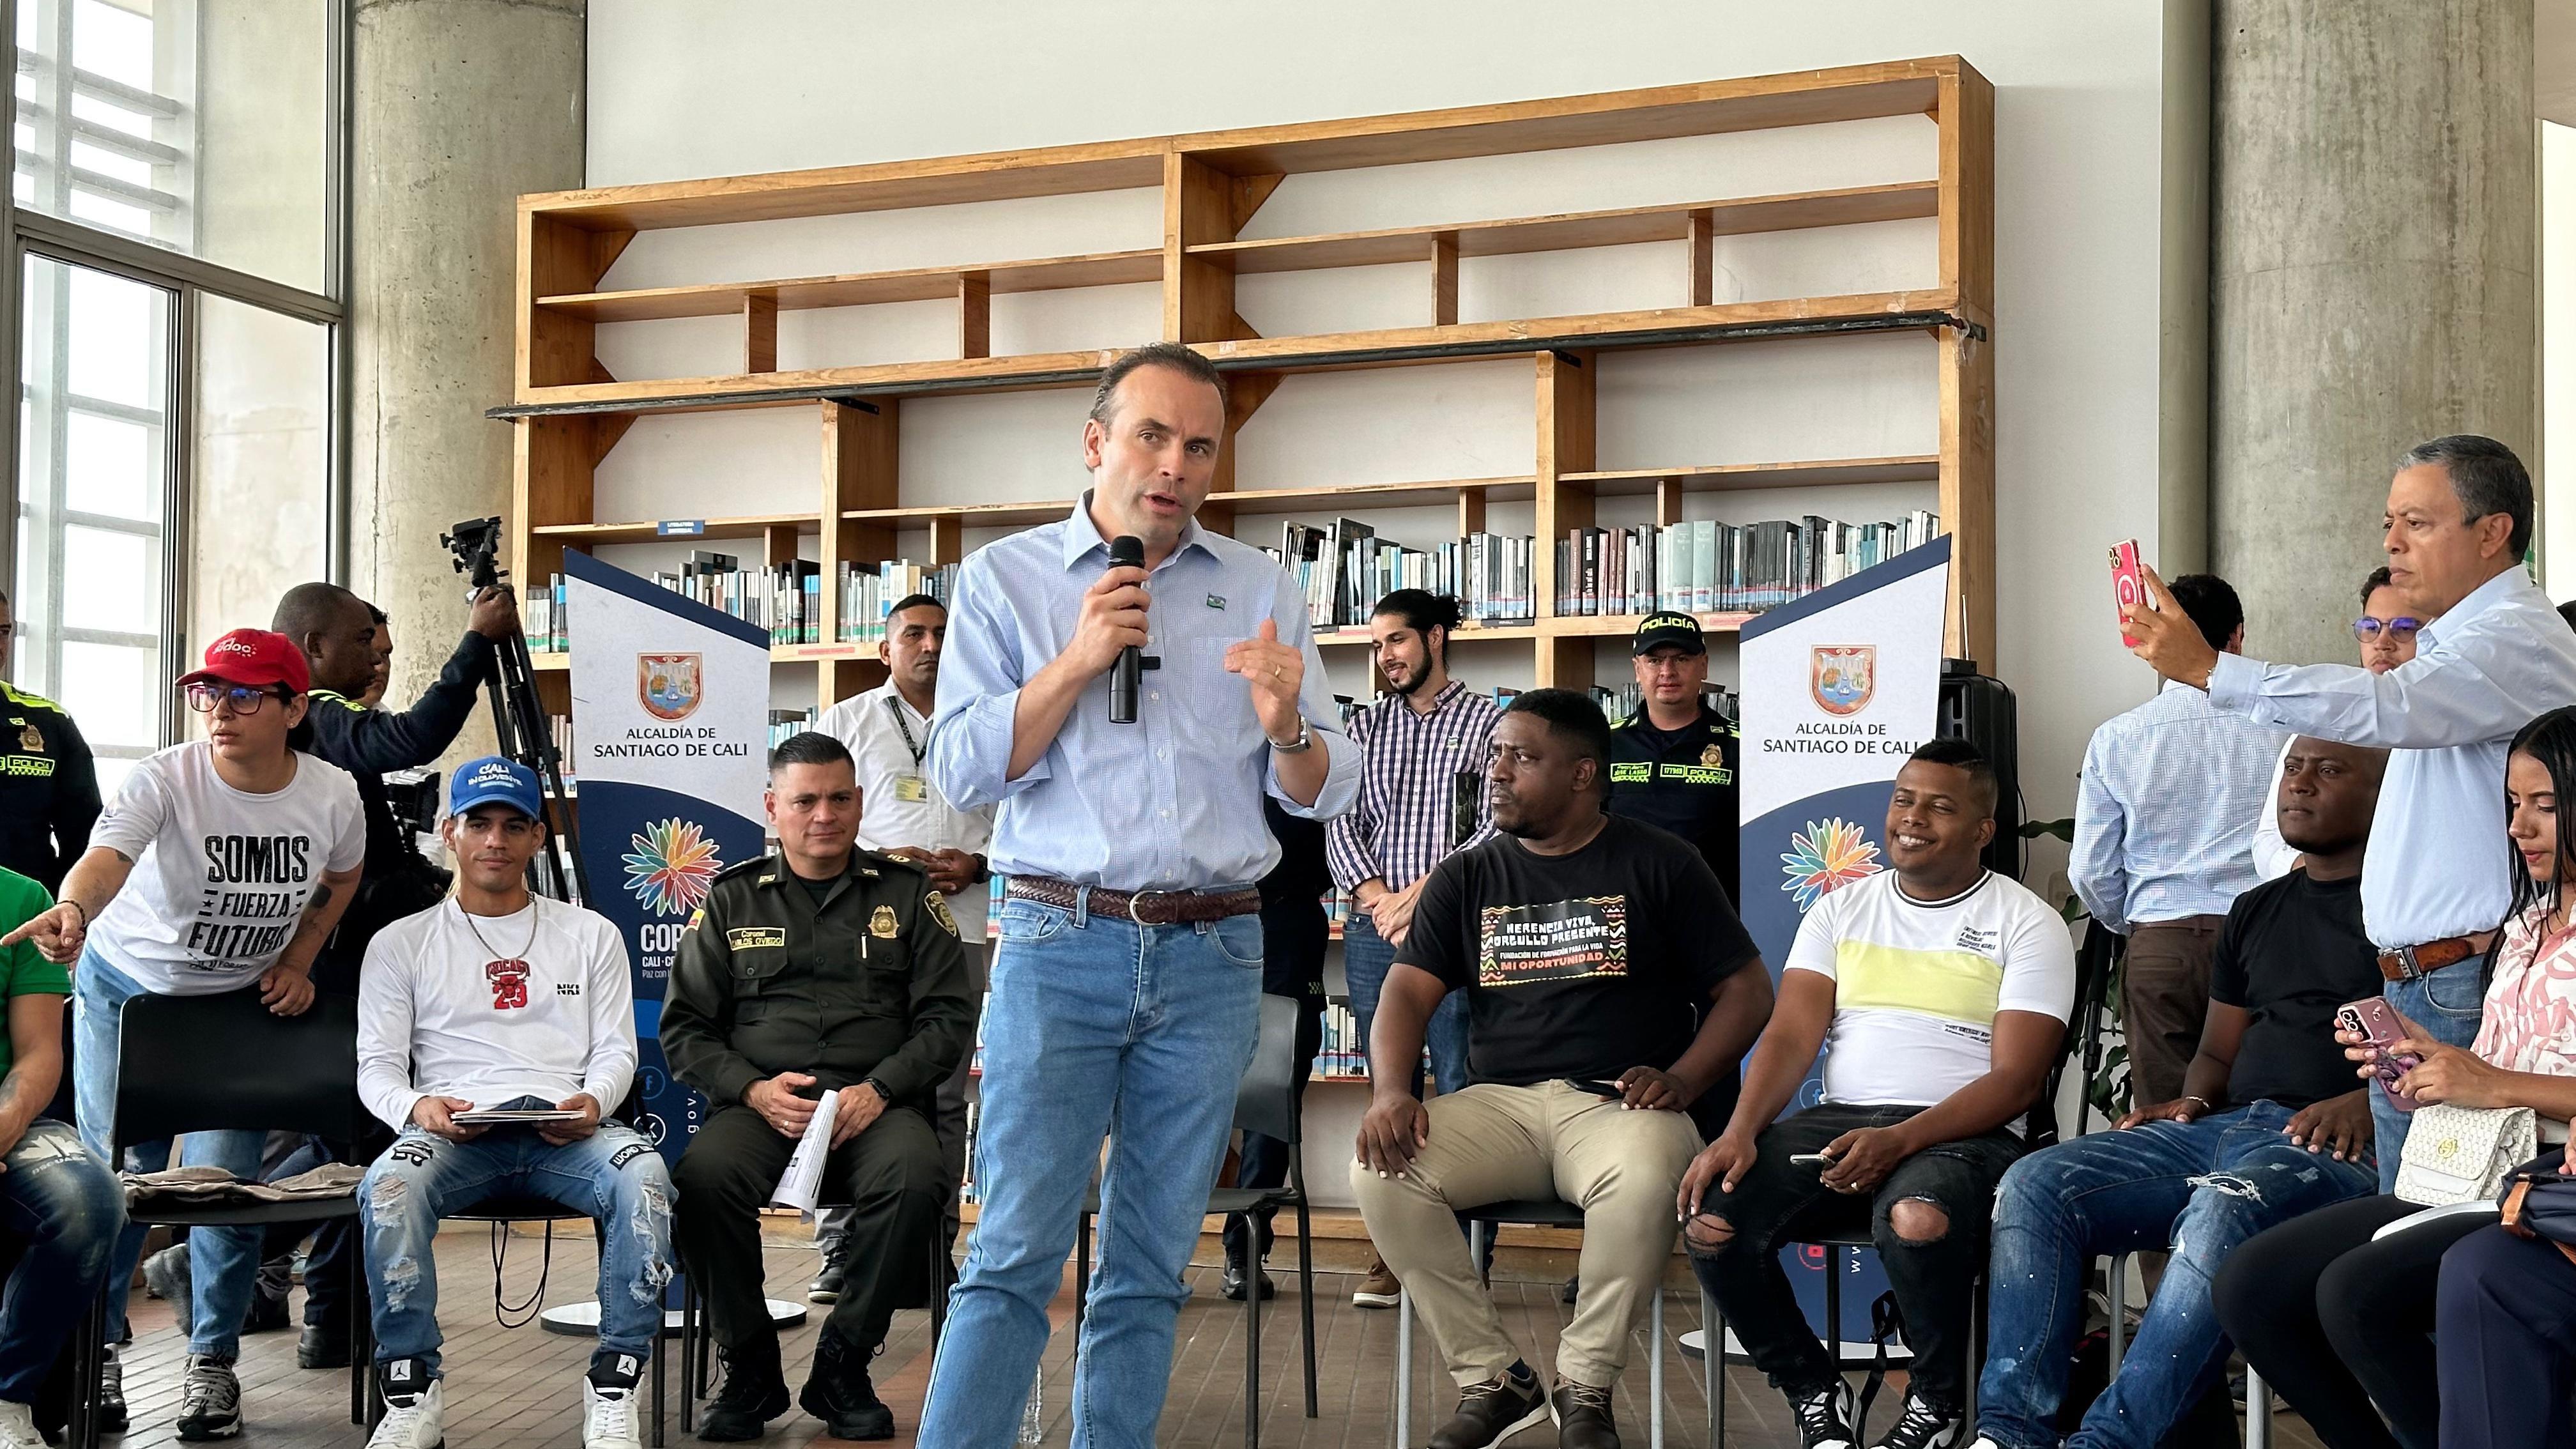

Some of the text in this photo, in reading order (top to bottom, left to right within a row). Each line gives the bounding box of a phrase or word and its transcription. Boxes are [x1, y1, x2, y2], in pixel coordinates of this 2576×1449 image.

[1640, 617, 1696, 634] POLICÍA
[626, 724, 716, 739] ALCALDÍA DE
[1795, 720, 1886, 735] ALCALDÍA DE
[594, 743, 747, 757] SANTIAGO DE CALI
[1763, 739, 1848, 753] SANTIAGO
[1855, 740, 1876, 753] DE
[479, 763, 510, 774] CALI
[205, 835, 309, 884] SOMOS
[219, 893, 290, 918] FUERZA
[1506, 921, 1563, 934] HERENCIA
[1494, 926, 1609, 946] ORGULLO PRESENTE
[1582, 944, 1589, 952] LA
[642, 956, 660, 967] CALI
[1501, 952, 1604, 970] MI OPORTUNIDAD
[642, 970, 654, 978] Paz
[493, 982, 528, 1009] 23
